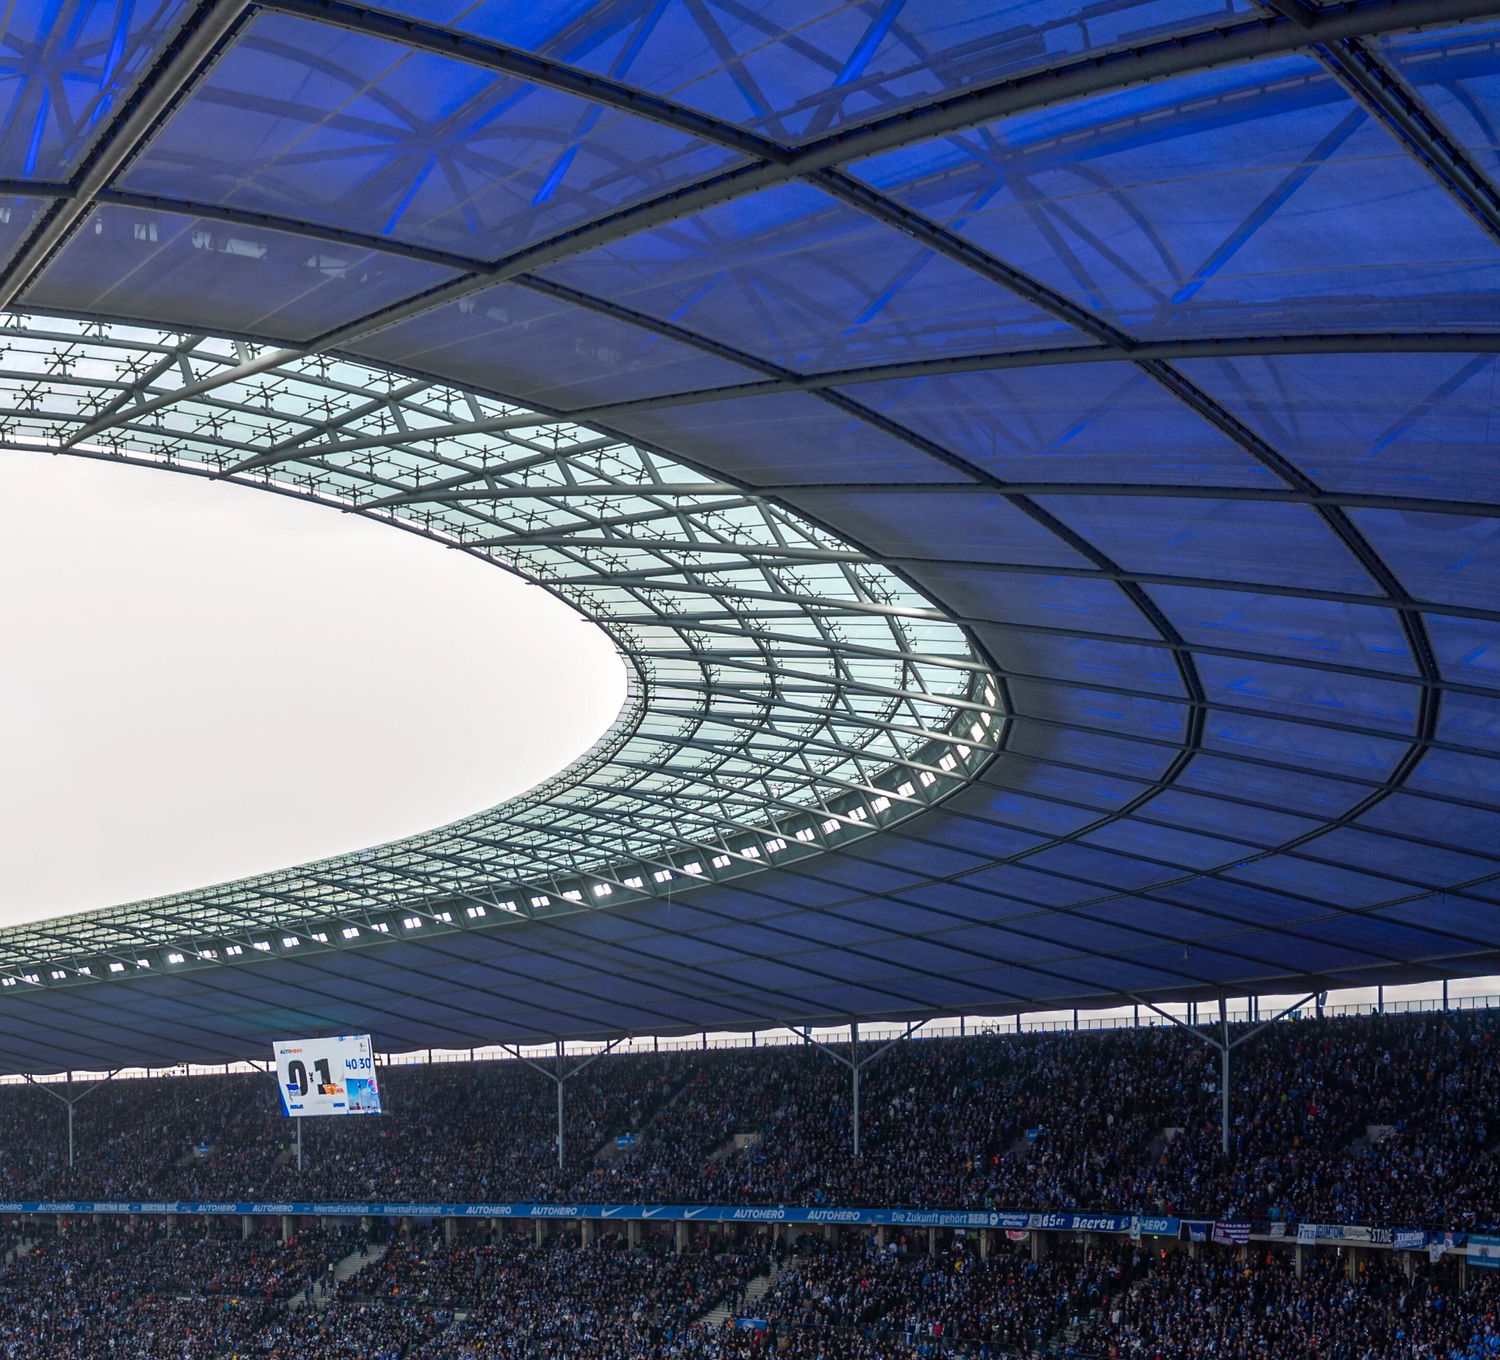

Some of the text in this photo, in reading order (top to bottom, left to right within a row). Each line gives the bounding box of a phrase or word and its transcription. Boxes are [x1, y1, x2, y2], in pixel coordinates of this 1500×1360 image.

[465, 1206, 512, 1215] AUTOHERO
[531, 1206, 578, 1216] AUTOHERO
[733, 1208, 785, 1218] AUTOHERO
[807, 1210, 860, 1221] AUTOHERO
[890, 1212, 904, 1222] Die
[905, 1212, 938, 1223] Zukunft
[939, 1214, 967, 1225] gehört
[1141, 1220, 1168, 1231] HERO
